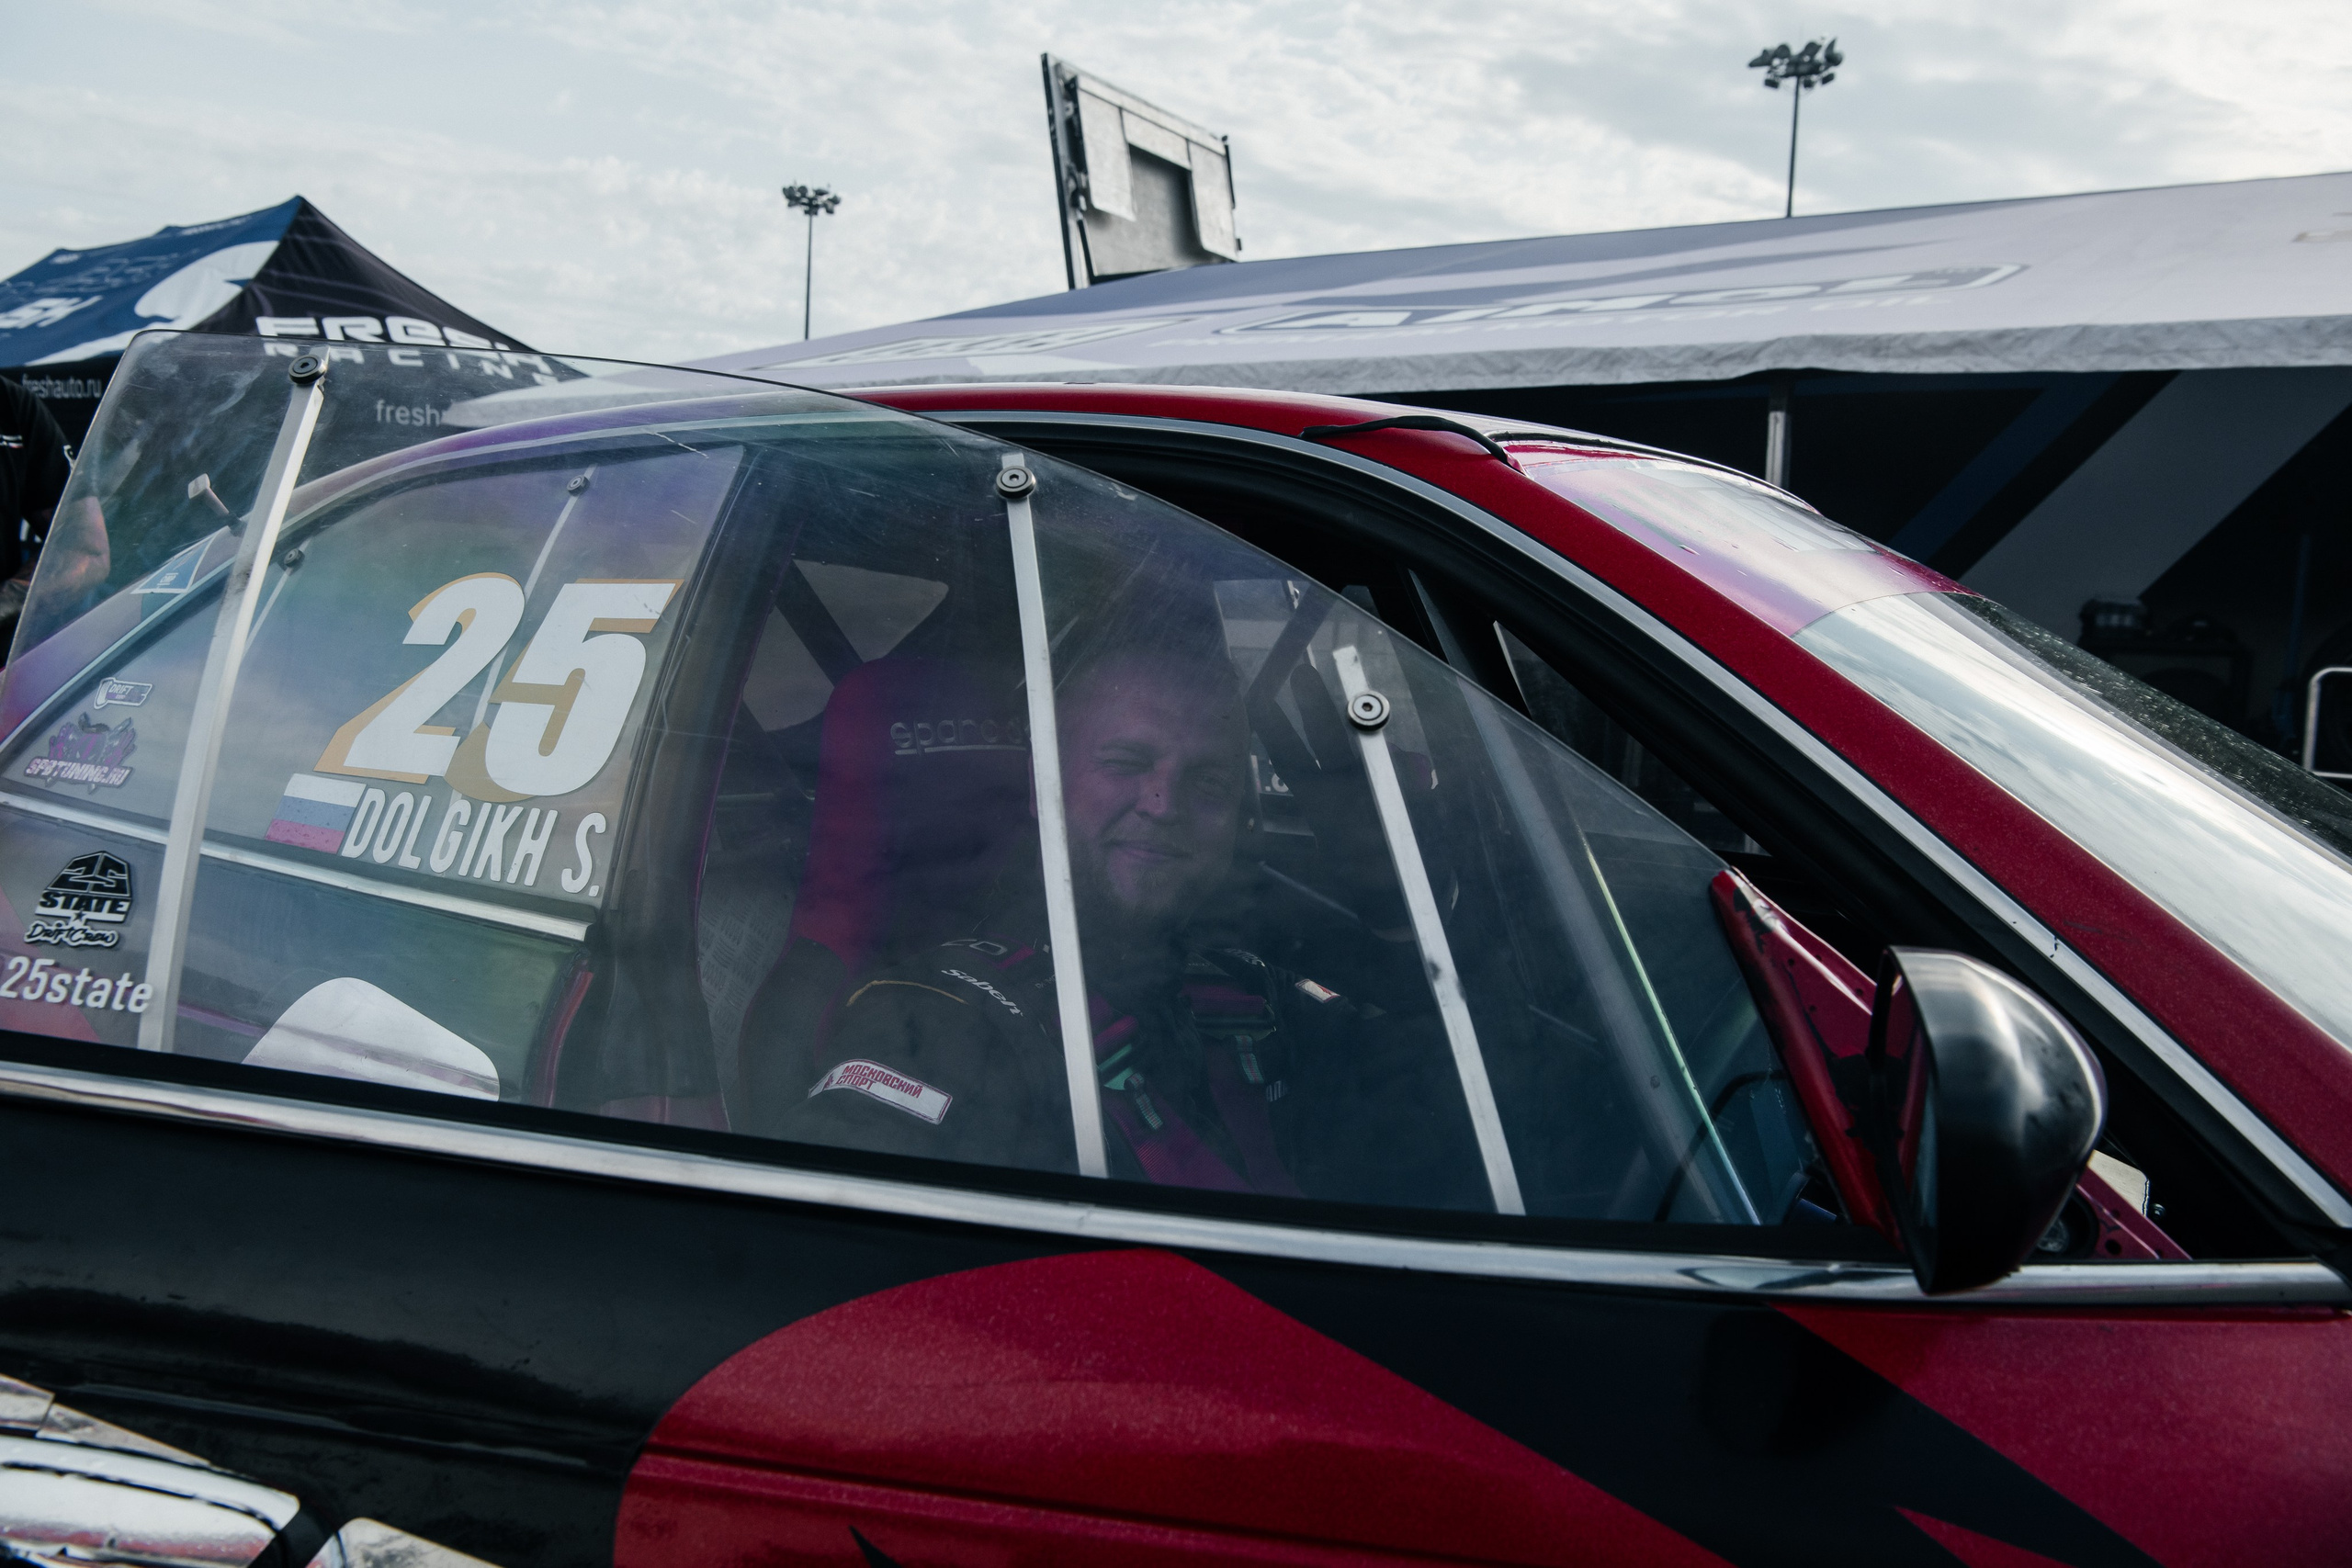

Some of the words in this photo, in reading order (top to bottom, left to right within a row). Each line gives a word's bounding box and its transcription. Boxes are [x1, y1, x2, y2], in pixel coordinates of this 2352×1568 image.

[1260, 274, 1948, 330] AIMOL
[344, 573, 677, 796] 25
[342, 787, 555, 887] DOLGIKH
[561, 812, 606, 897] S.
[39, 891, 130, 915] STATE
[0, 955, 153, 1013] 25state
[835, 1075, 876, 1090] СПОРТ
[842, 1065, 923, 1099] МОСКОВСКИЙ
